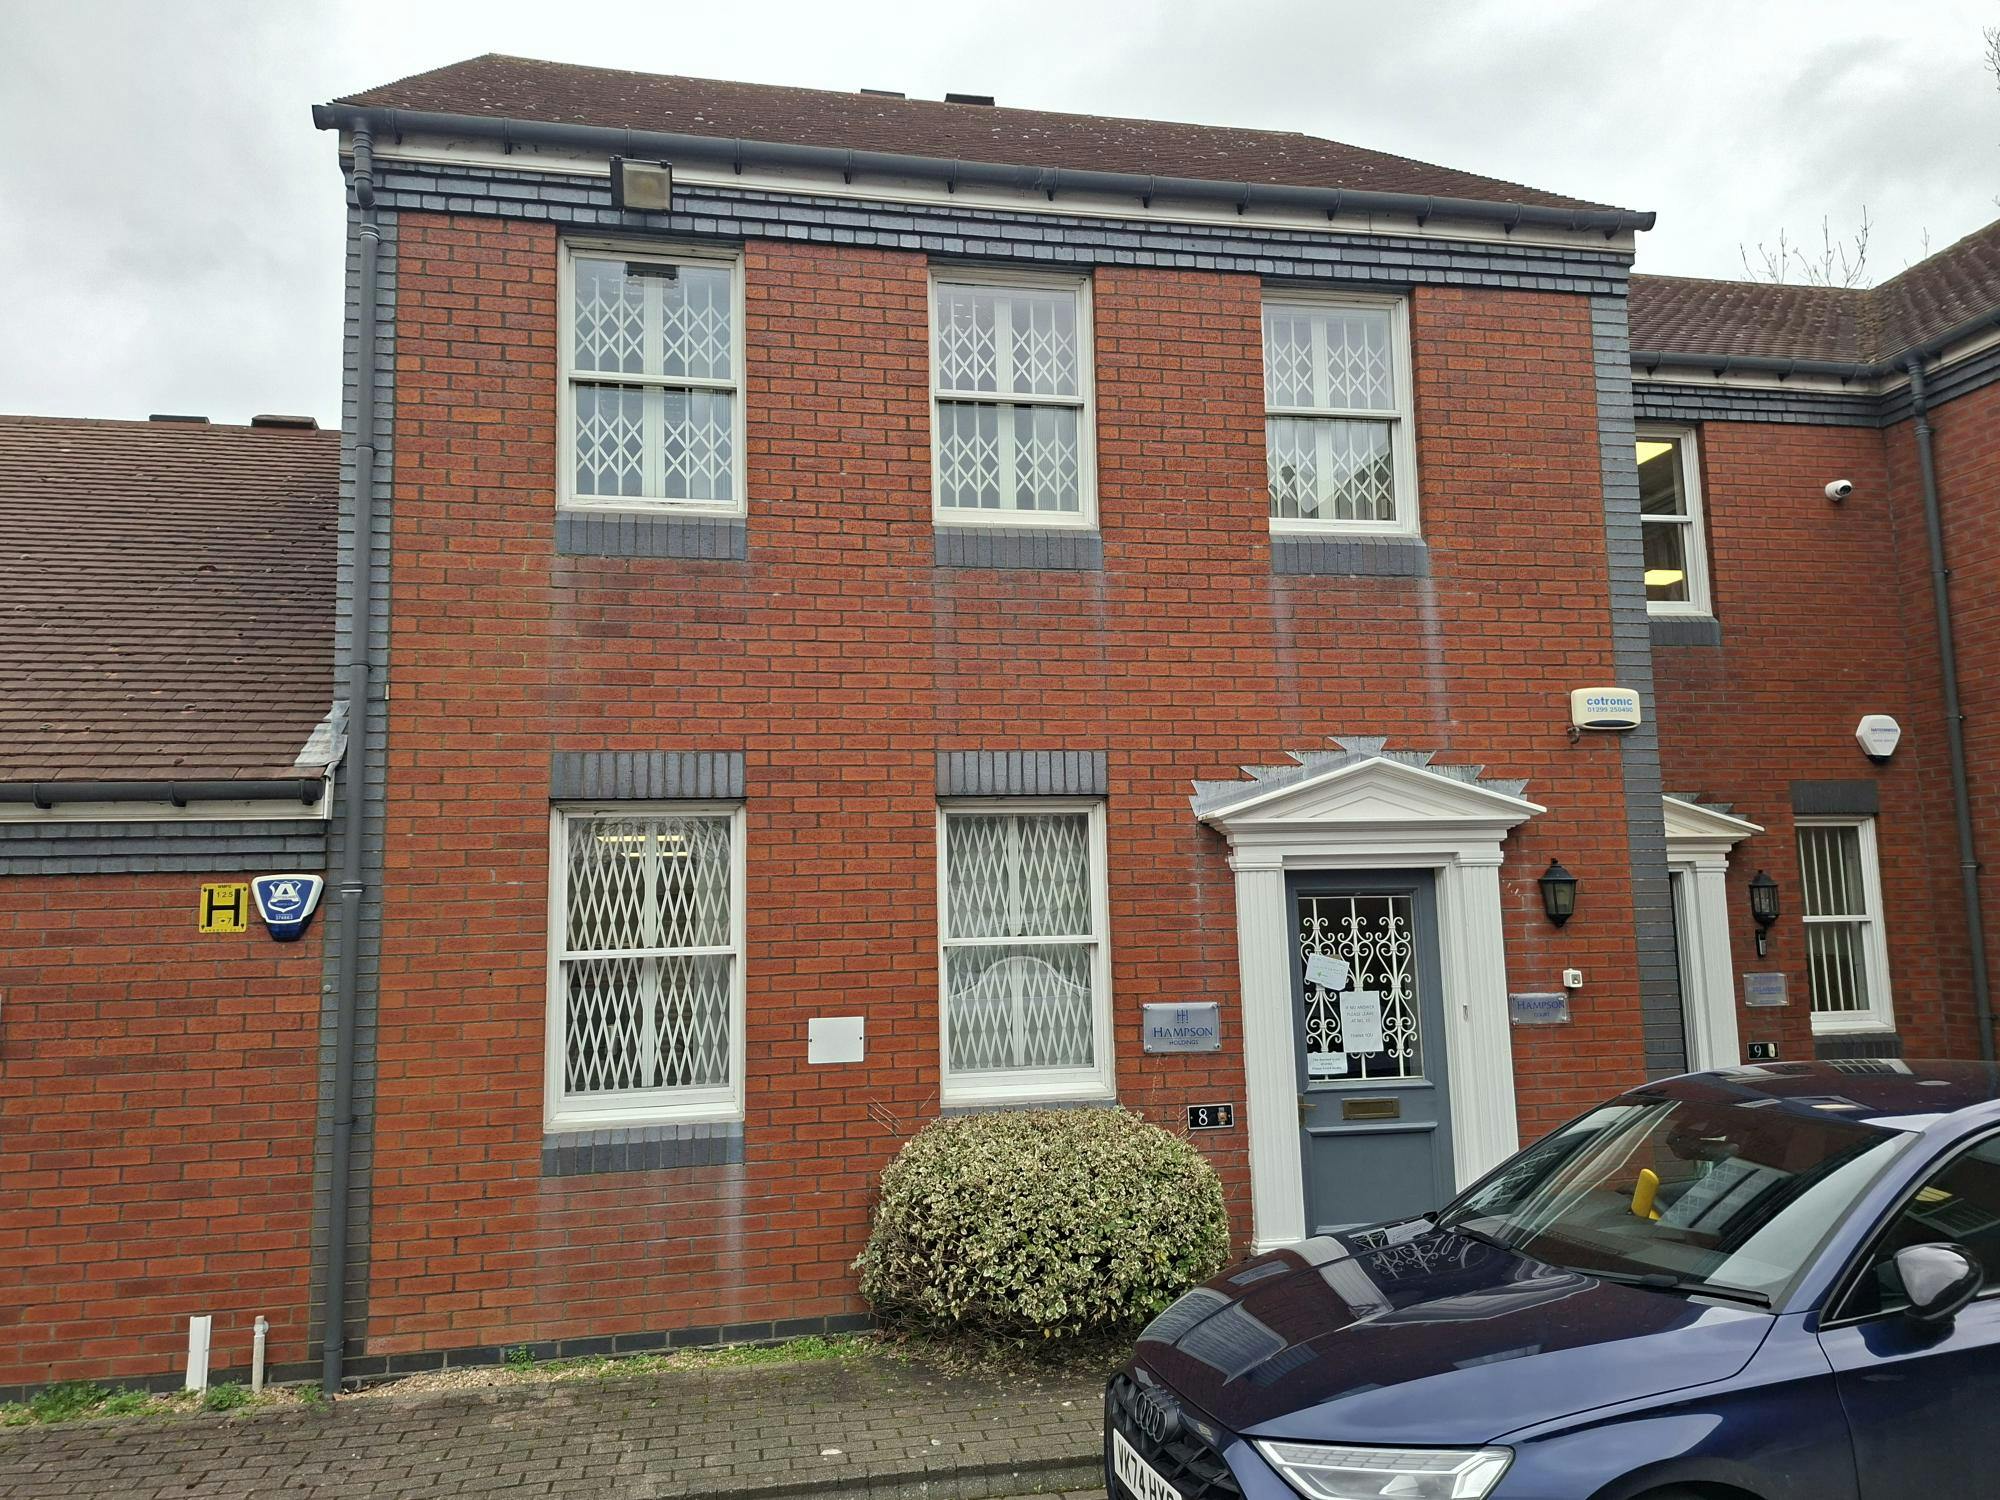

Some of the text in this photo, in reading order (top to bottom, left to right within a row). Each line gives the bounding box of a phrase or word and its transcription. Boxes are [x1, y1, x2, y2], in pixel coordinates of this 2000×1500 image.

[1587, 696, 1633, 706] cotronic
[206, 889, 241, 927] H
[1517, 1000, 1565, 1010] HAMPSON
[1153, 1026, 1213, 1038] HAMPSON
[1754, 1044, 1762, 1058] 9
[1198, 1108, 1208, 1126] 8
[1117, 1438, 1146, 1499] VK74
